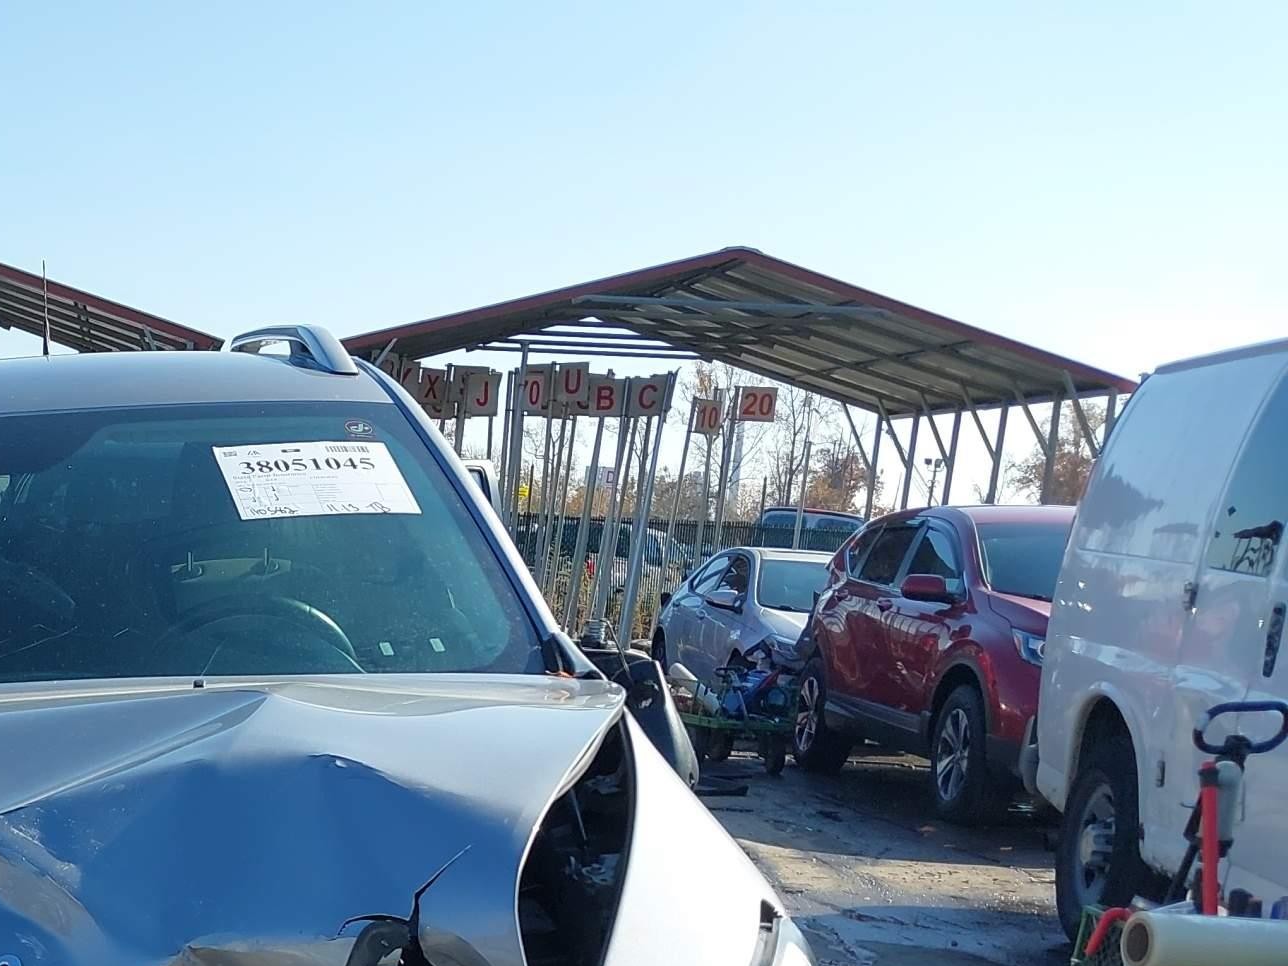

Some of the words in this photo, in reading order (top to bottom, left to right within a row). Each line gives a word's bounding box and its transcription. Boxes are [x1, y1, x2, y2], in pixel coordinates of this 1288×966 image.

[423, 373, 440, 400] X
[475, 380, 489, 407] J
[564, 368, 582, 395] U
[595, 384, 615, 411] B
[637, 383, 659, 410] C
[741, 391, 774, 417] 20
[699, 404, 719, 429] 10
[238, 456, 376, 475] 38051045
